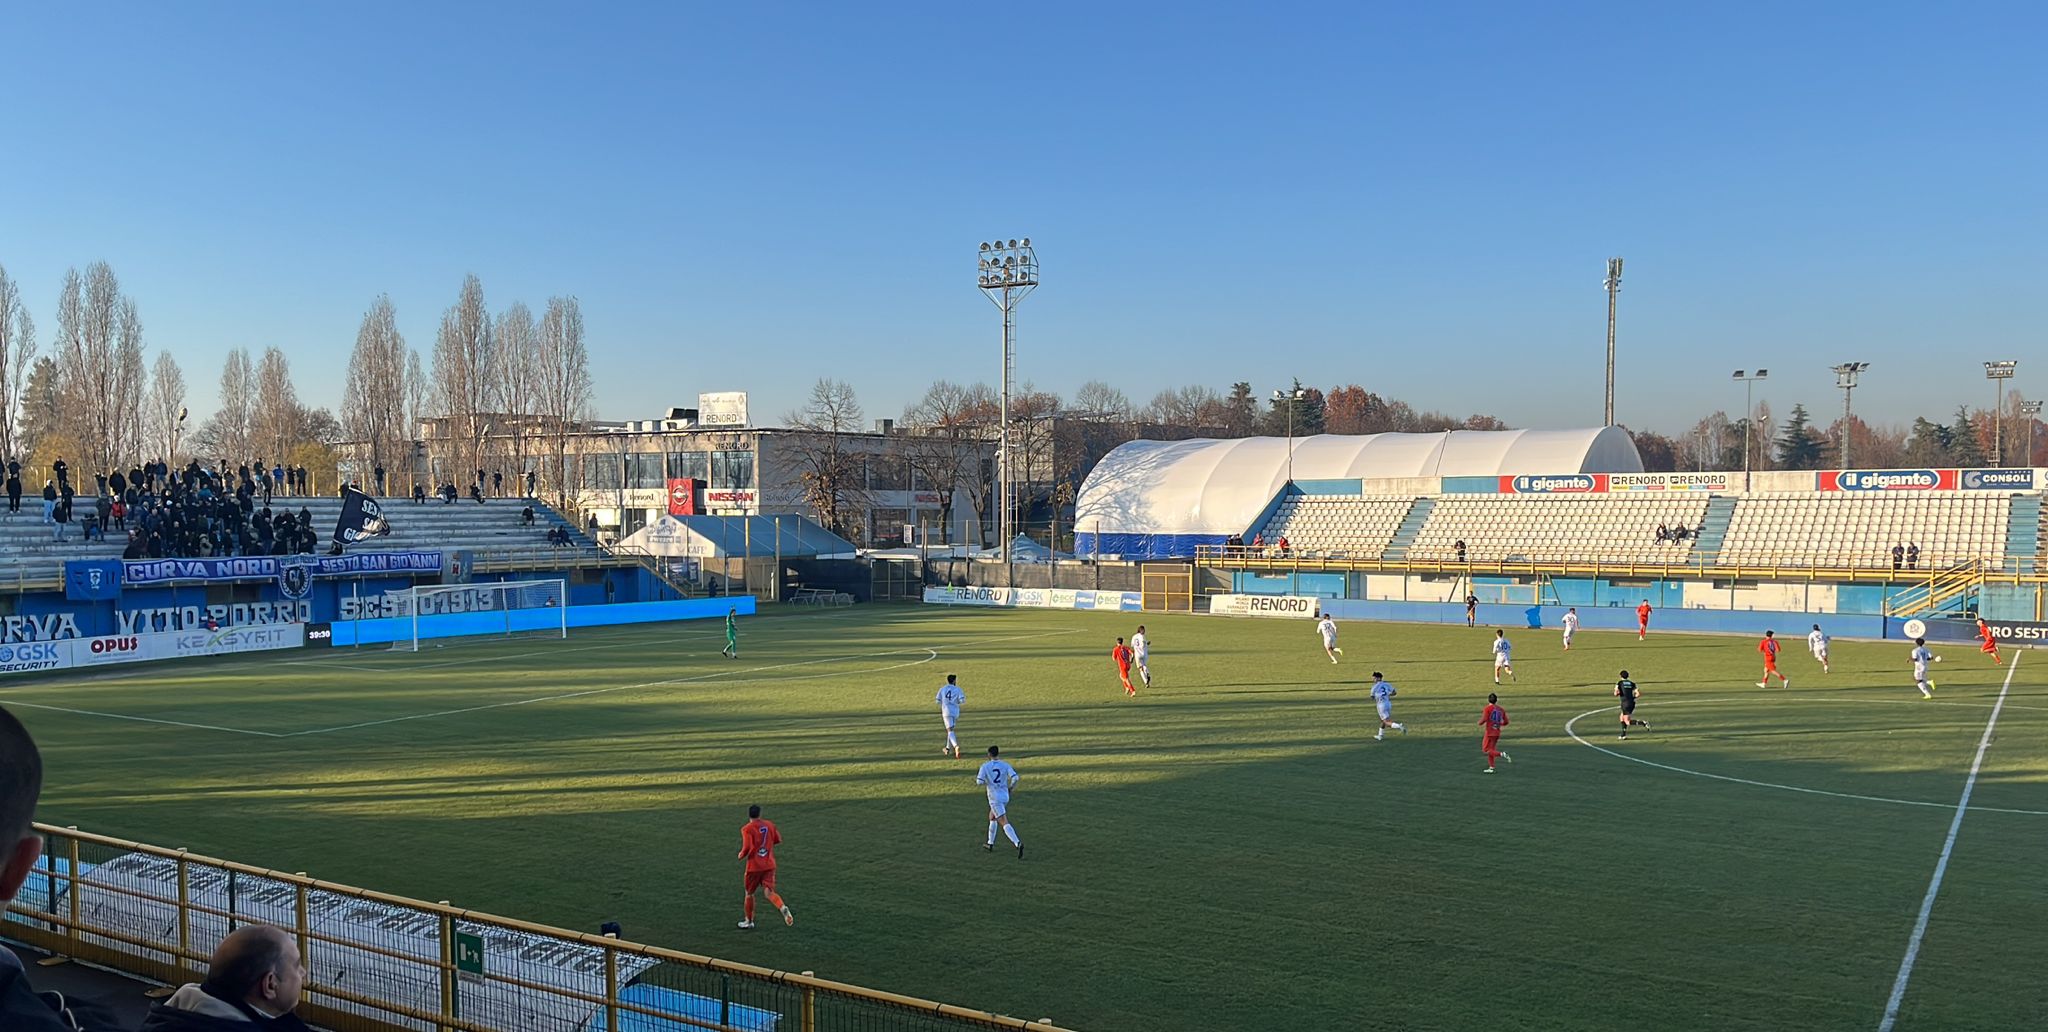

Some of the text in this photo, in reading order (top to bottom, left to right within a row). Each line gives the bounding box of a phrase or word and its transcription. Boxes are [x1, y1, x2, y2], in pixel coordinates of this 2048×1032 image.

[1519, 476, 1589, 491] il gigante
[1621, 476, 1665, 485] RENORD
[1680, 475, 1726, 484] RENORD
[1845, 472, 1932, 489] il gigante
[1982, 474, 2031, 483] CONSOLI
[708, 492, 754, 502] NISSAN
[128, 561, 209, 580] CURVA
[216, 558, 276, 577] NORD
[321, 556, 360, 572] SESTO
[362, 555, 388, 570] SAN
[390, 553, 439, 569] GIOVANNI
[956, 588, 1002, 601] RENORD
[1250, 597, 1308, 612] RENORD
[0, 612, 82, 642] RVA
[308, 630, 331, 640] 39:30
[16, 642, 59, 661] GSK
[90, 637, 138, 654] OPUS
[0, 660, 59, 672] SECURITY
[945, 690, 953, 701] 4
[992, 768, 1001, 784] 2
[759, 826, 768, 848] 7
